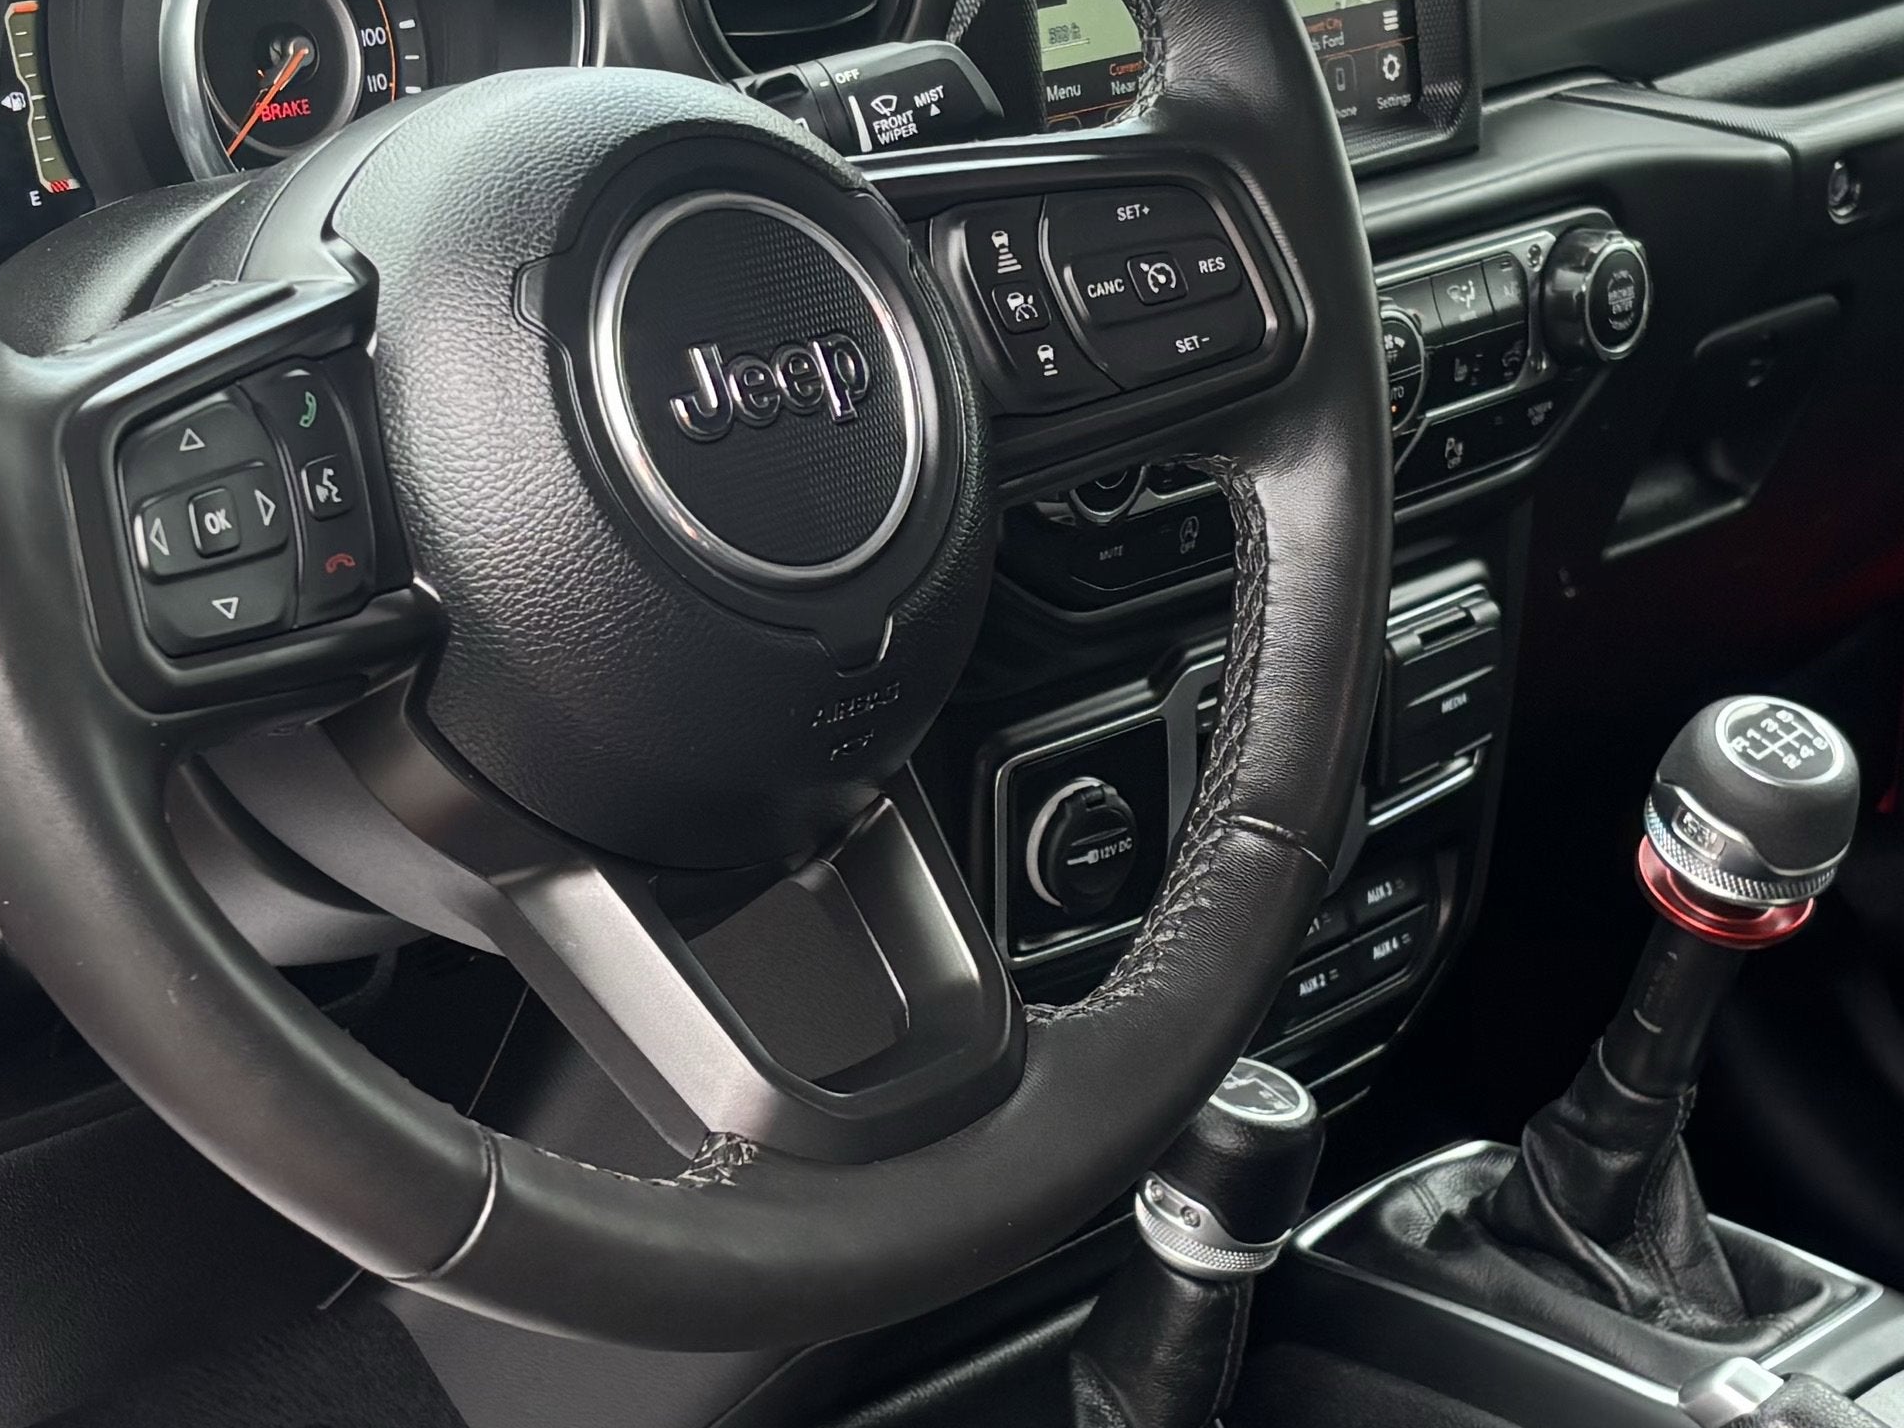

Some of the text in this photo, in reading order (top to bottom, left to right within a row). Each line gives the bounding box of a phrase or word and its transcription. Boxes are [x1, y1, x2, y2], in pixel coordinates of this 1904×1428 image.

[360, 26, 386, 47] 100
[367, 73, 388, 93] 110
[835, 69, 860, 84] OFF
[913, 85, 945, 109] MIST
[1046, 84, 1081, 103] Menu
[1376, 94, 1411, 110] Settings
[259, 99, 311, 122] BRAKE
[872, 109, 914, 134] FRONT
[876, 123, 919, 146] WIPER
[29, 190, 42, 206] E
[1116, 204, 1151, 222] SET+
[1198, 256, 1226, 274] RES
[1087, 278, 1125, 299] CANC
[669, 333, 869, 442] Jeep
[204, 508, 232, 534] OK
[1441, 692, 1468, 714] MEDIA
[1100, 837, 1133, 860] 12V DC
[1367, 884, 1386, 905] AUX
[1373, 939, 1392, 960] AUX
[1299, 976, 1318, 997] AUX
